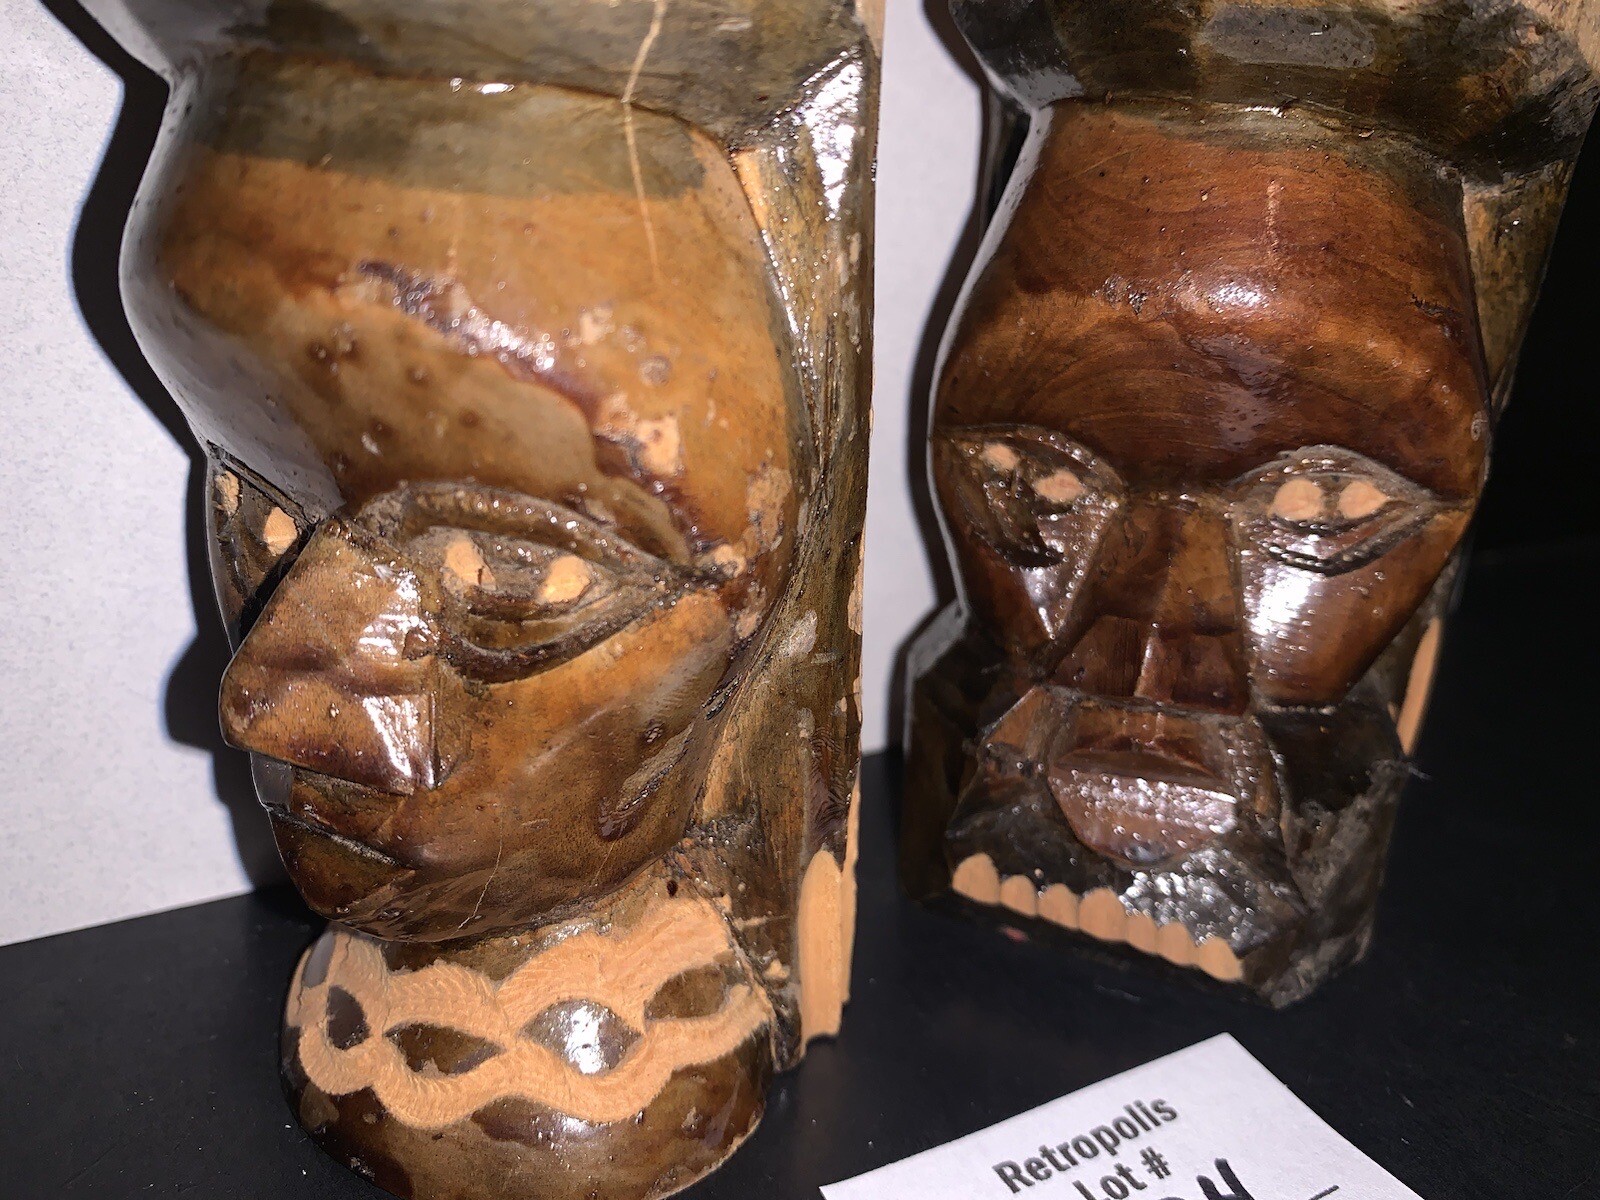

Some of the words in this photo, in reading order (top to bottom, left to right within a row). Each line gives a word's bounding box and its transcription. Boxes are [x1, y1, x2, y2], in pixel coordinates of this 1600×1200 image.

[993, 1097, 1178, 1194] Retropolis
[1073, 1162, 1142, 1200] Lot
[1141, 1146, 1173, 1180] #
